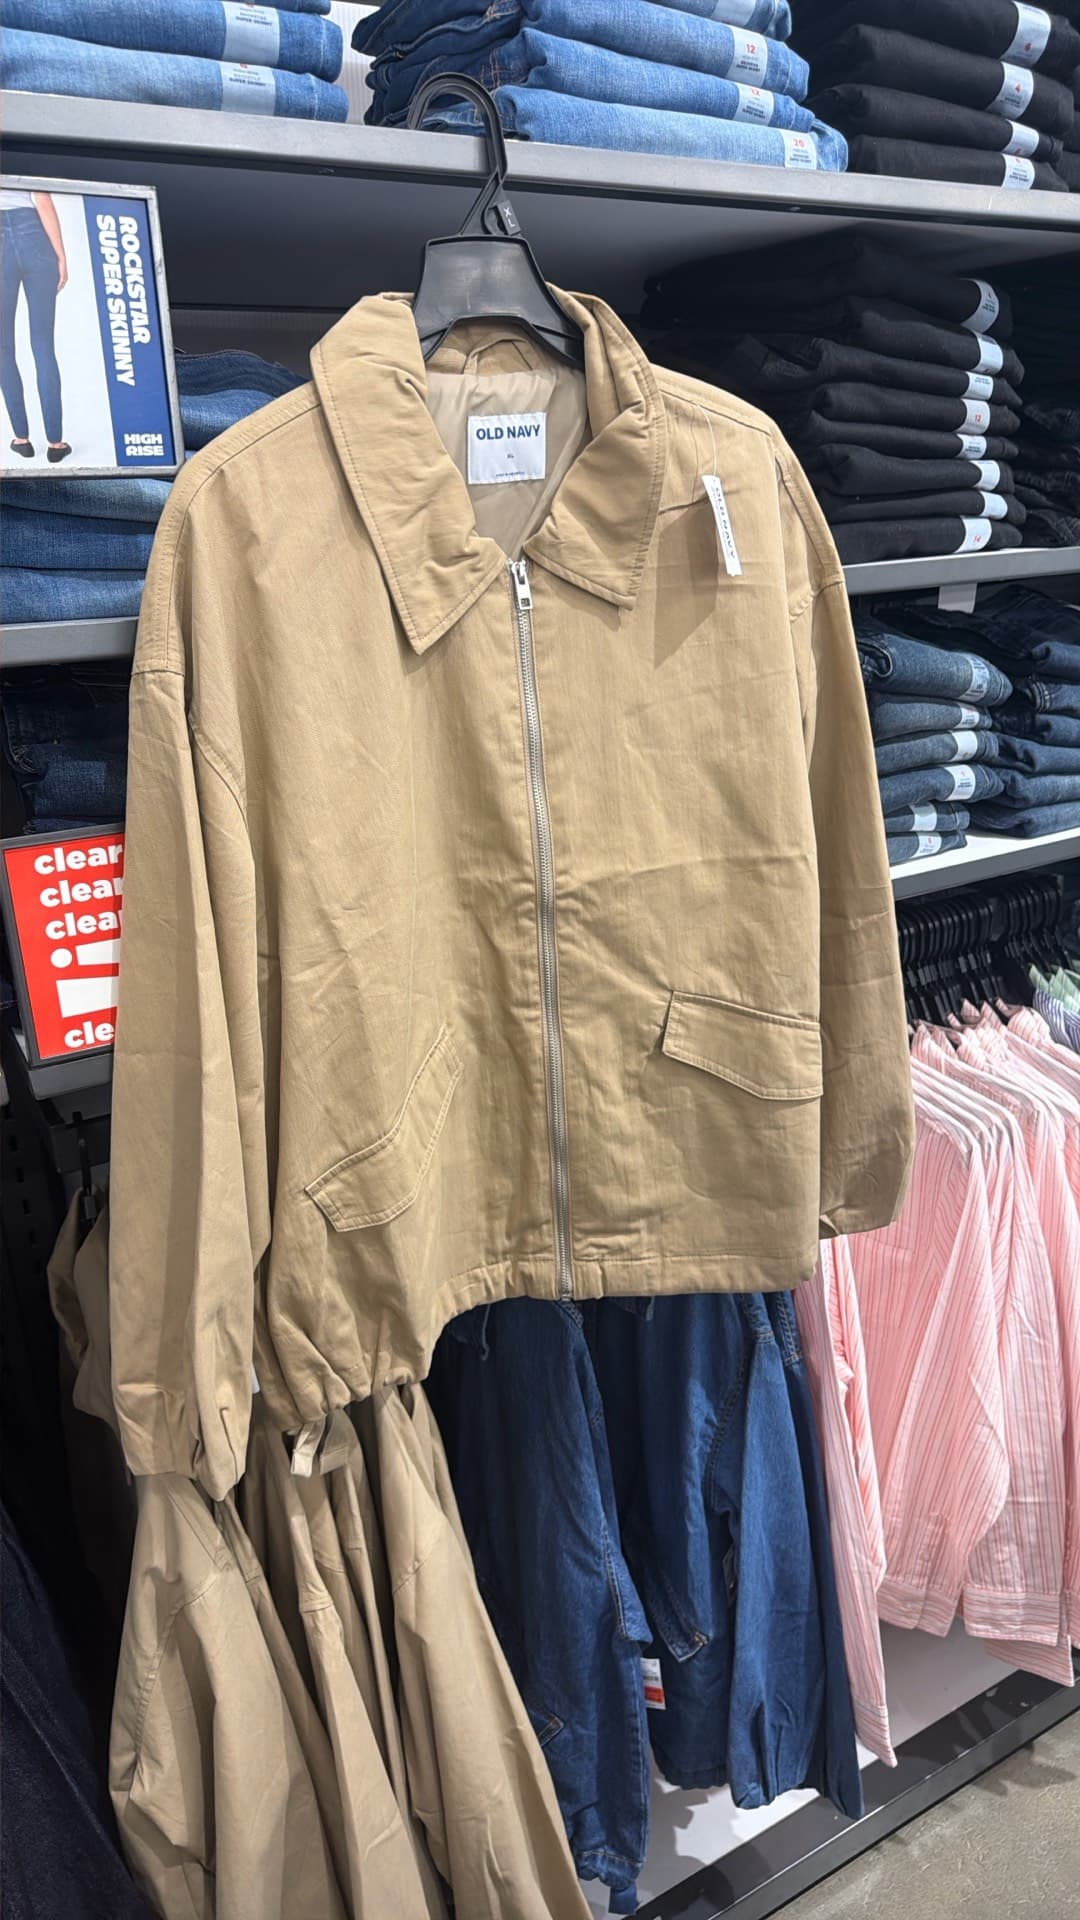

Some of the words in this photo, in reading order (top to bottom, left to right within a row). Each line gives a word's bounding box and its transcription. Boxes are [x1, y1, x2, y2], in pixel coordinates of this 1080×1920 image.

[746, 43, 756, 54] 12
[503, 207, 516, 228] XL
[96, 214, 124, 296] SUPER
[118, 215, 151, 345] ROCKSTAR
[106, 296, 136, 387] SKINNY
[124, 433, 163, 446] HIGH
[475, 427, 504, 440] OLD
[506, 424, 541, 439] NAVY
[125, 444, 164, 457] RISE
[715, 487, 725, 516] OLD
[722, 519, 736, 558] NAVY
[34, 844, 123, 875] clear
[45, 910, 121, 940] clea
